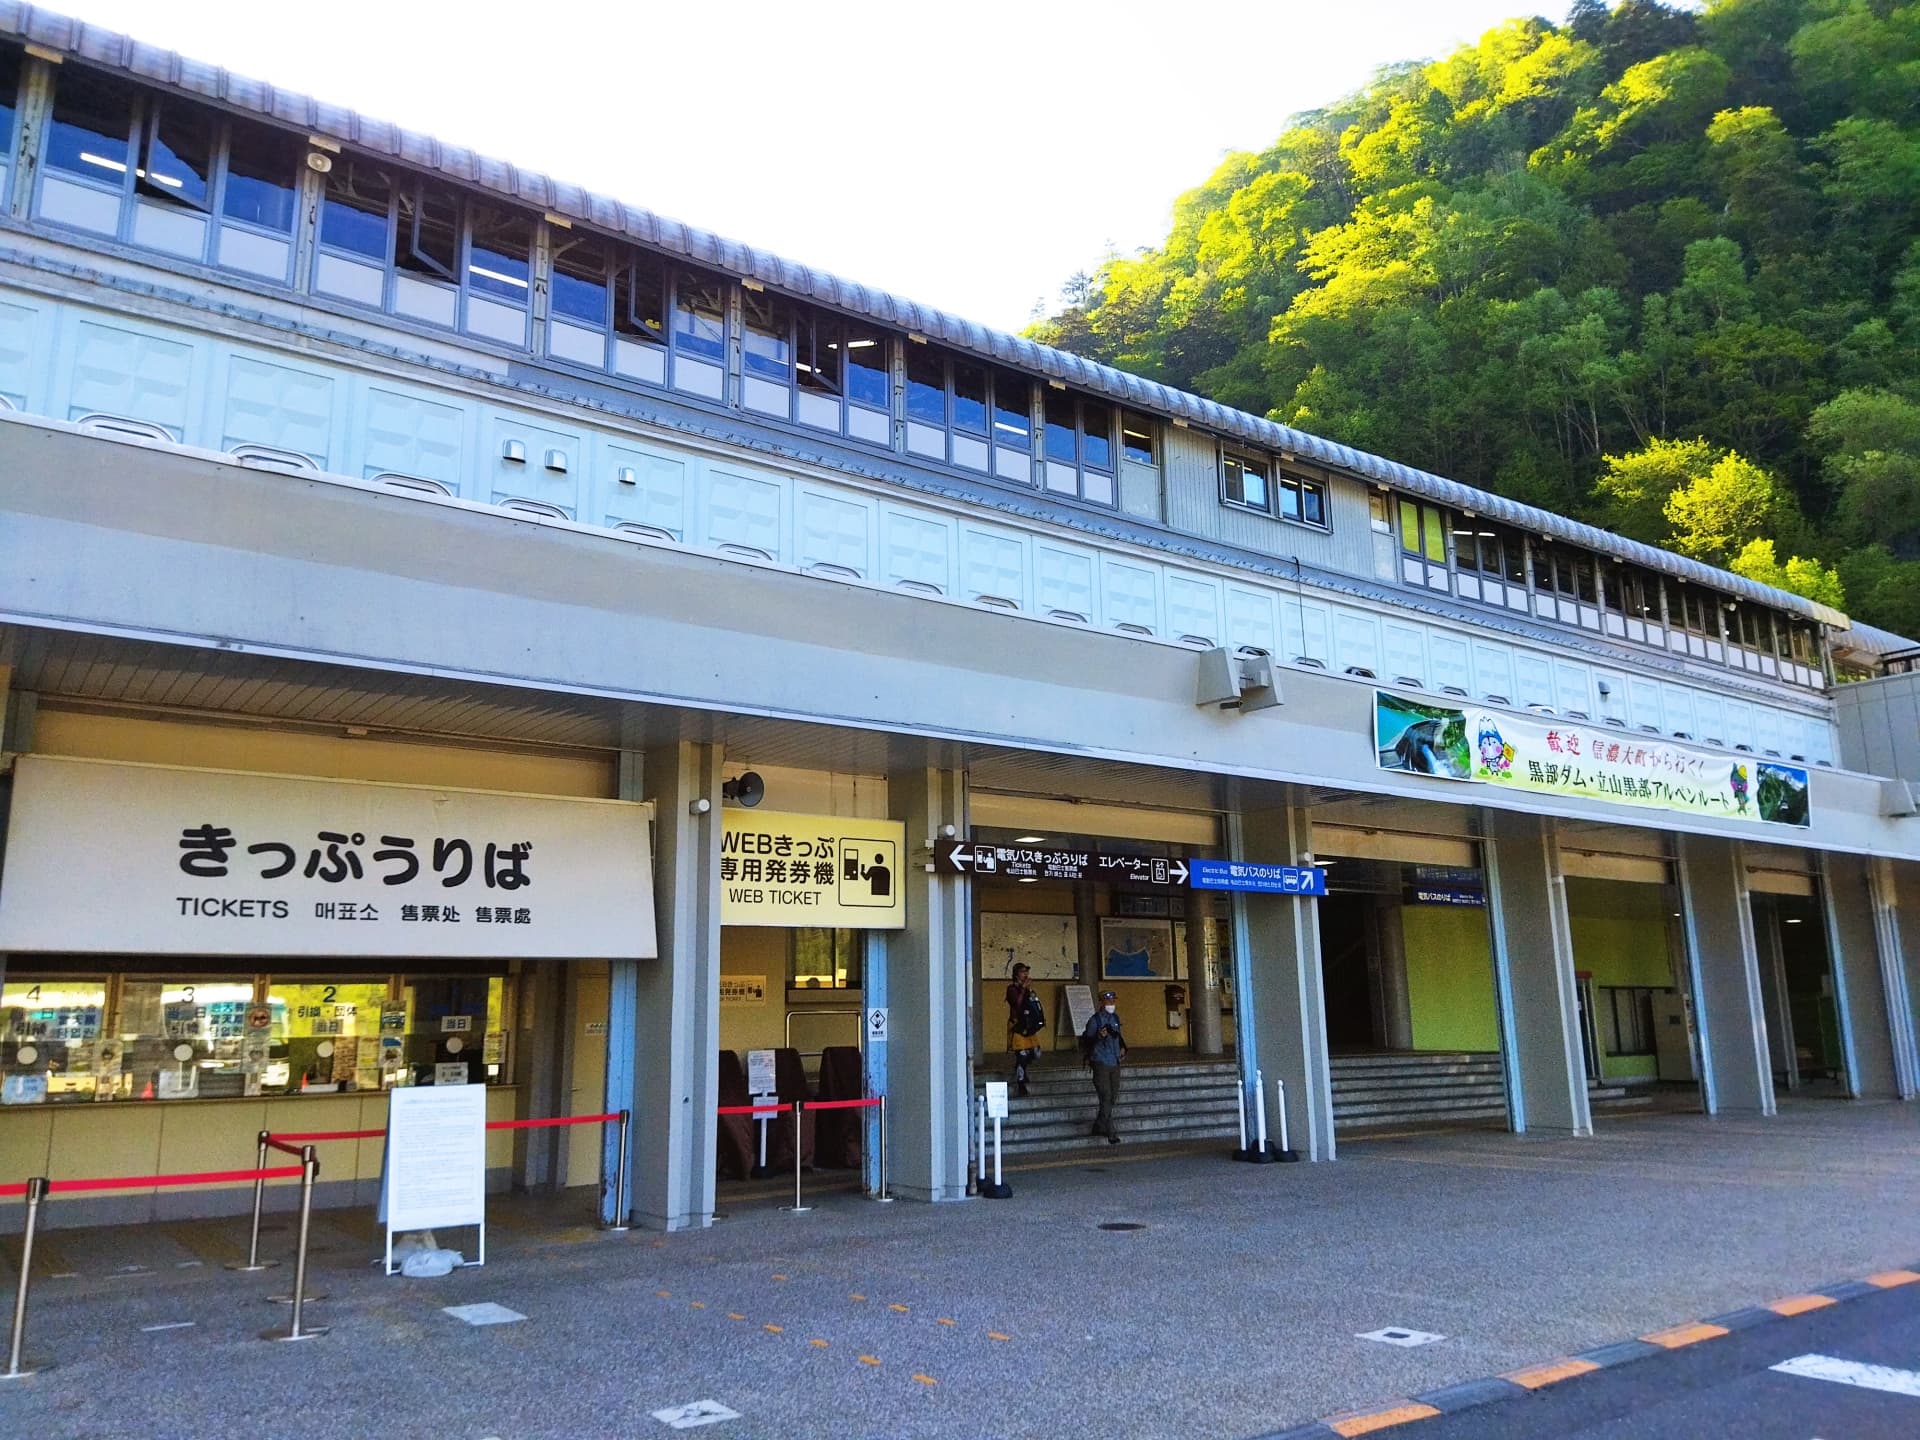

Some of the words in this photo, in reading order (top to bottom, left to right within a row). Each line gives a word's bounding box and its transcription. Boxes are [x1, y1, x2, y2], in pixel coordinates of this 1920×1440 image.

[1529, 760, 1729, 810] 黒部ダム・立山黒部アルペンルート
[721, 831, 835, 858] WEBきっぷ
[179, 824, 533, 890] きっぷうりば
[1099, 856, 1150, 870] エレベーター
[721, 857, 834, 885] 専用発券機
[1230, 865, 1281, 879] 電気バスのりば
[729, 889, 763, 904] WEB
[769, 890, 821, 905] TICKET
[176, 898, 289, 919] TICKETS
[315, 902, 378, 921] 매표소
[400, 904, 461, 923] 售票处
[475, 906, 531, 924] 售票處
[26, 985, 41, 1003] 4
[181, 986, 195, 1004] 3
[323, 986, 337, 1003] 2
